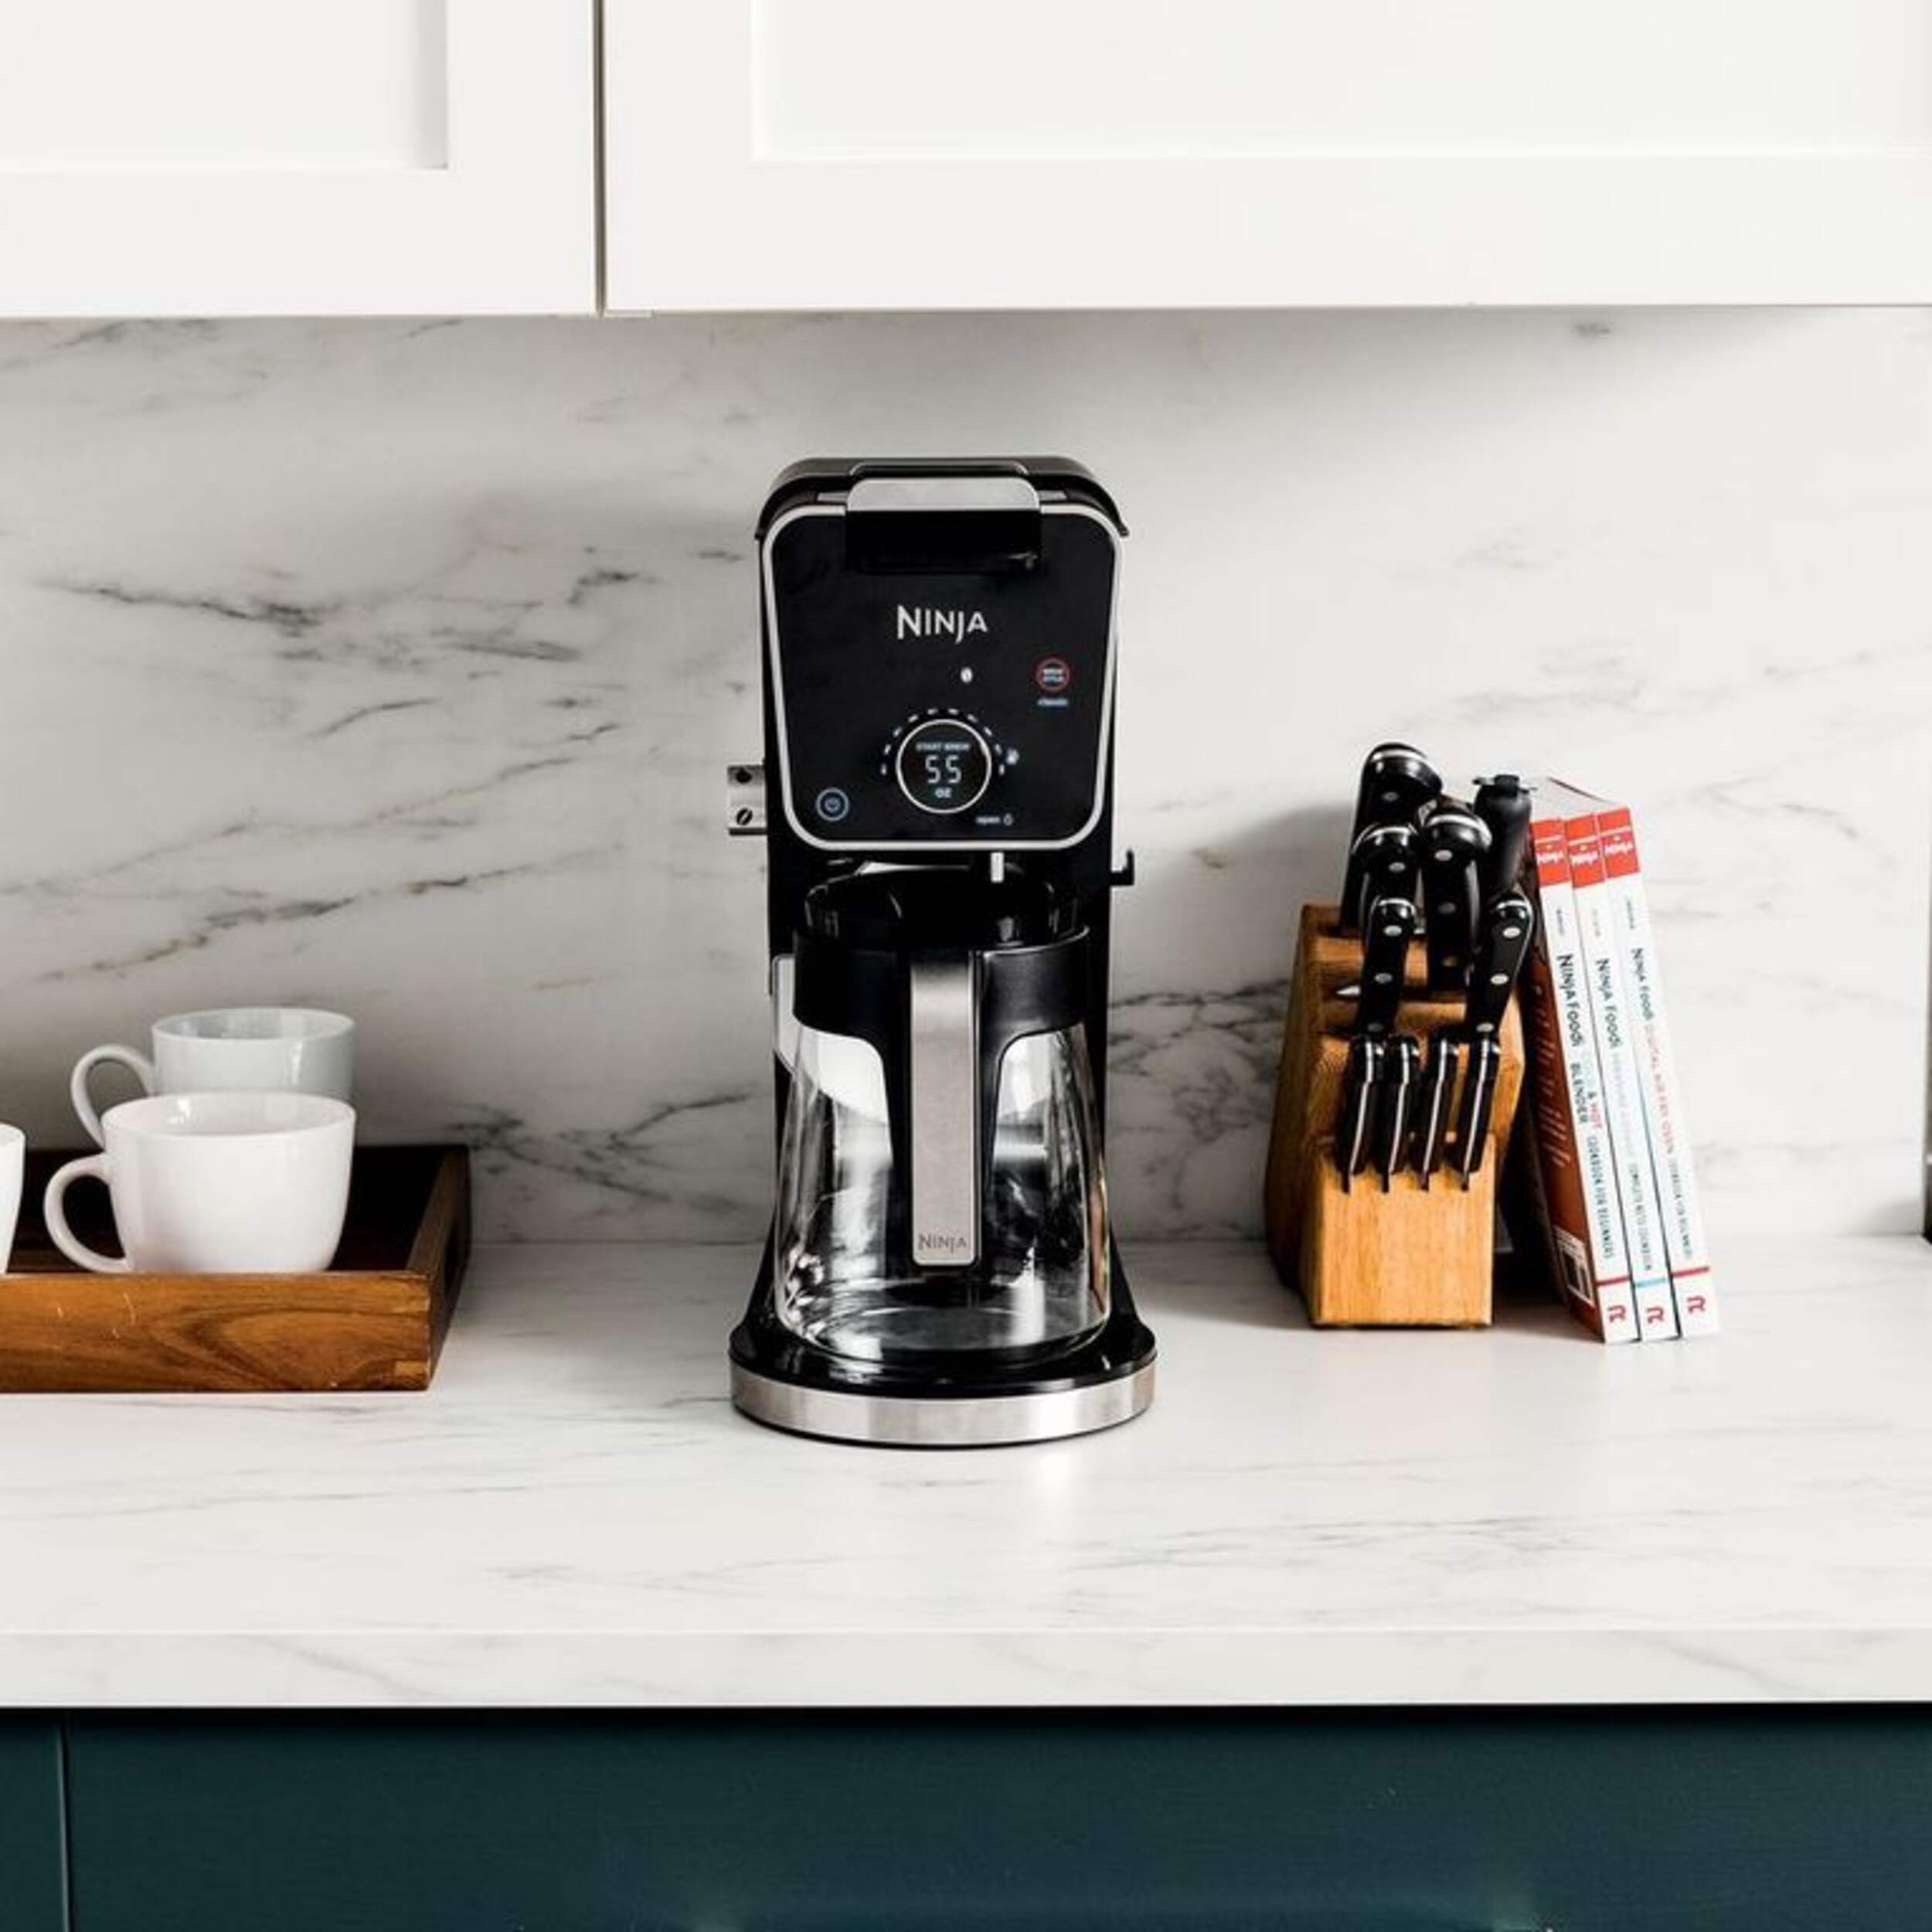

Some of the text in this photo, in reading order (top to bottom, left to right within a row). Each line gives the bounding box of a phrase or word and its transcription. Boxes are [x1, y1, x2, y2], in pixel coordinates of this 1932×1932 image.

[896, 604, 988, 644] NINJA
[1556, 954, 1578, 1000] NINJA
[1595, 958, 1614, 1002] NINJA
[918, 1233, 967, 1254] NINJA
